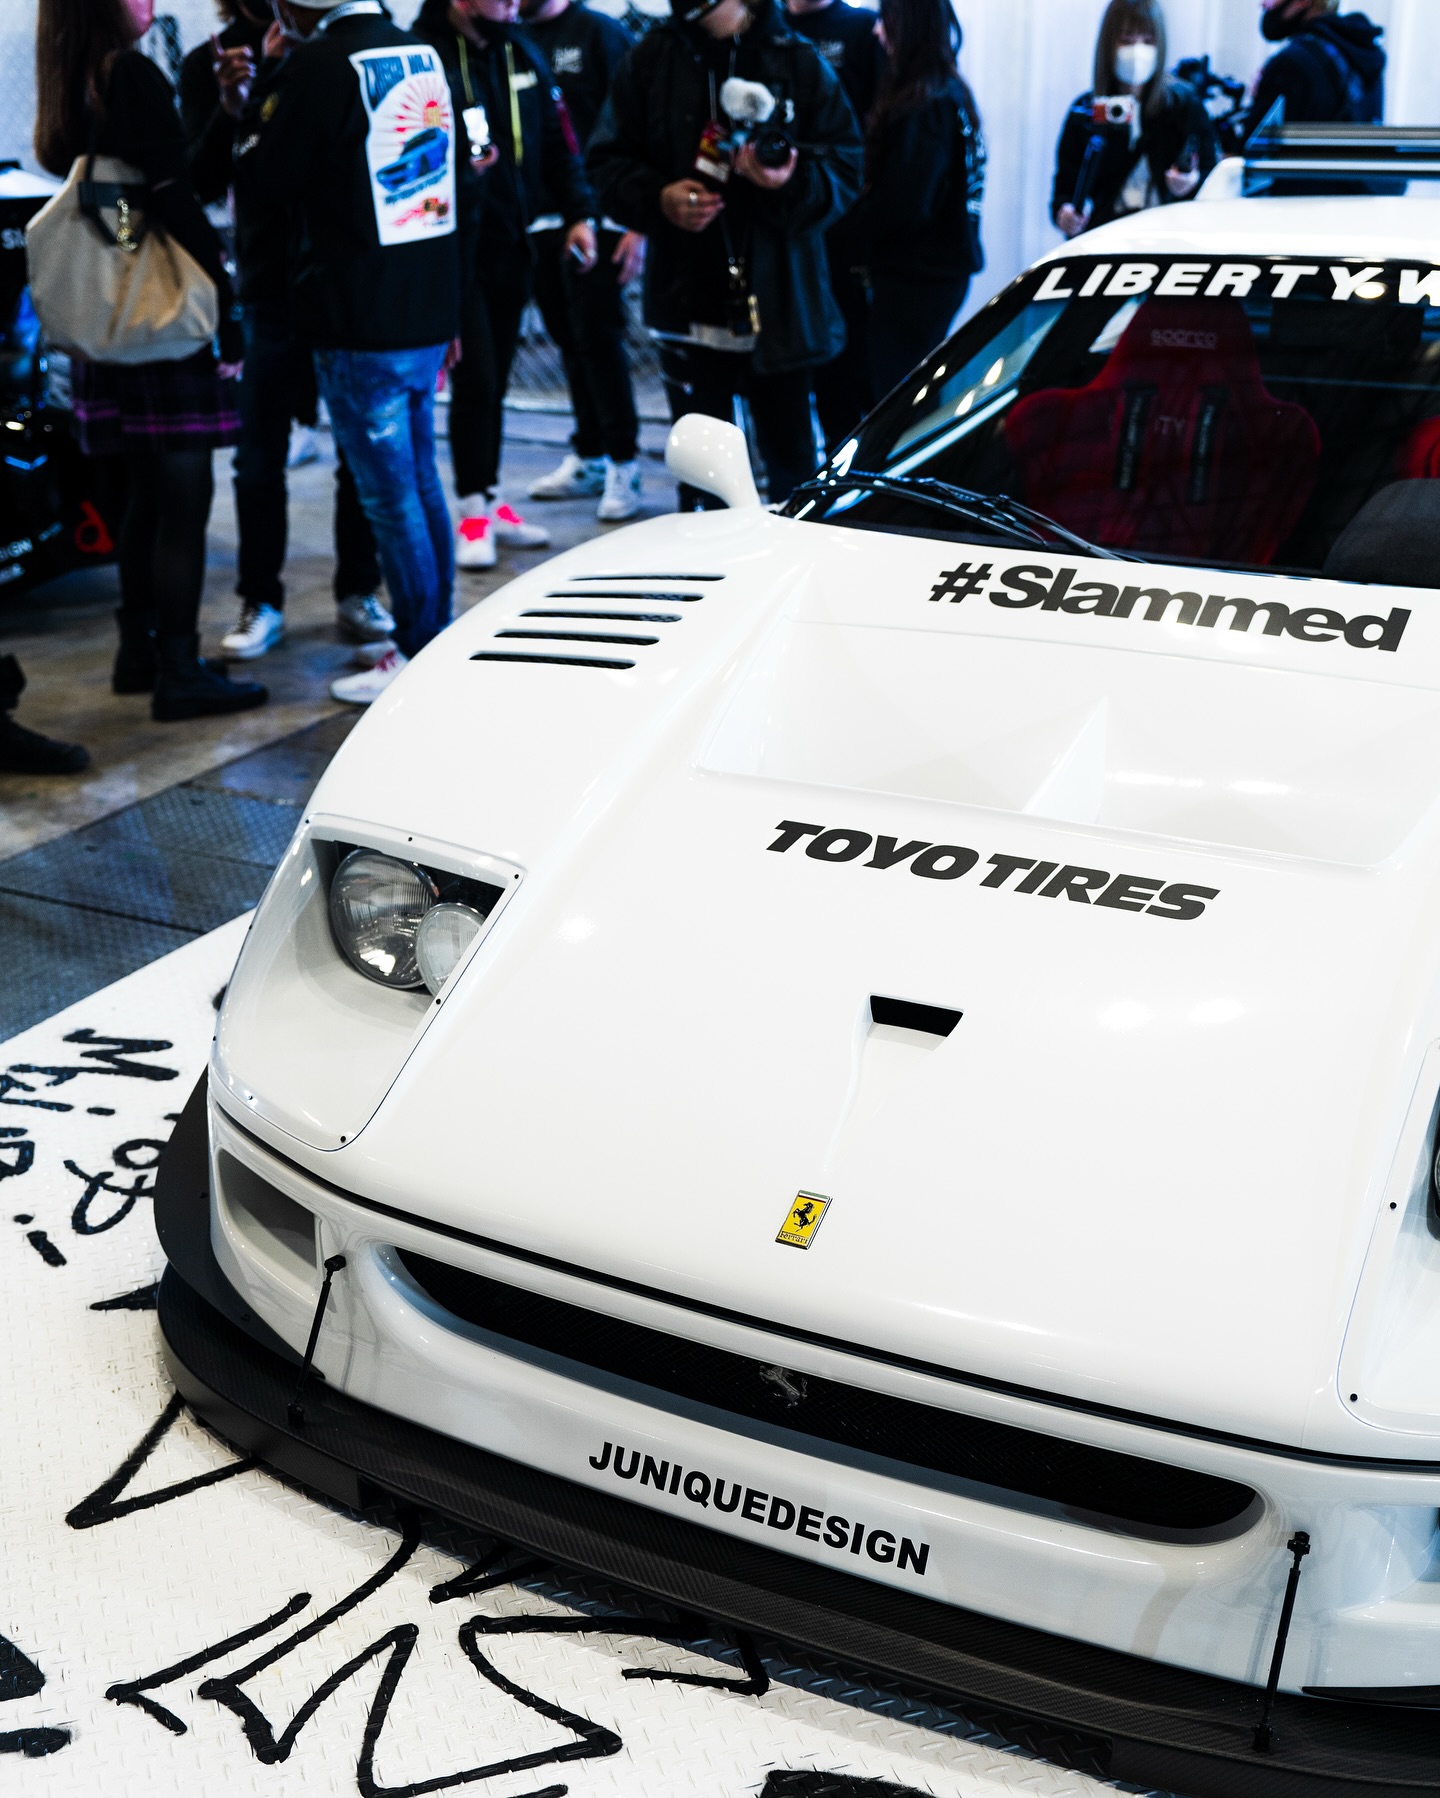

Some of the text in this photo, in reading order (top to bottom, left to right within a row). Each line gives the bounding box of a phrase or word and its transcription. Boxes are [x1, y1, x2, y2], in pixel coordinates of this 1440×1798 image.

[1032, 263, 1384, 301] LIBERTY
[928, 562, 1412, 652] #Slammed
[766, 820, 1221, 921] TOYO TIRES
[588, 1441, 930, 1576] JUNIQUEDESIGN
